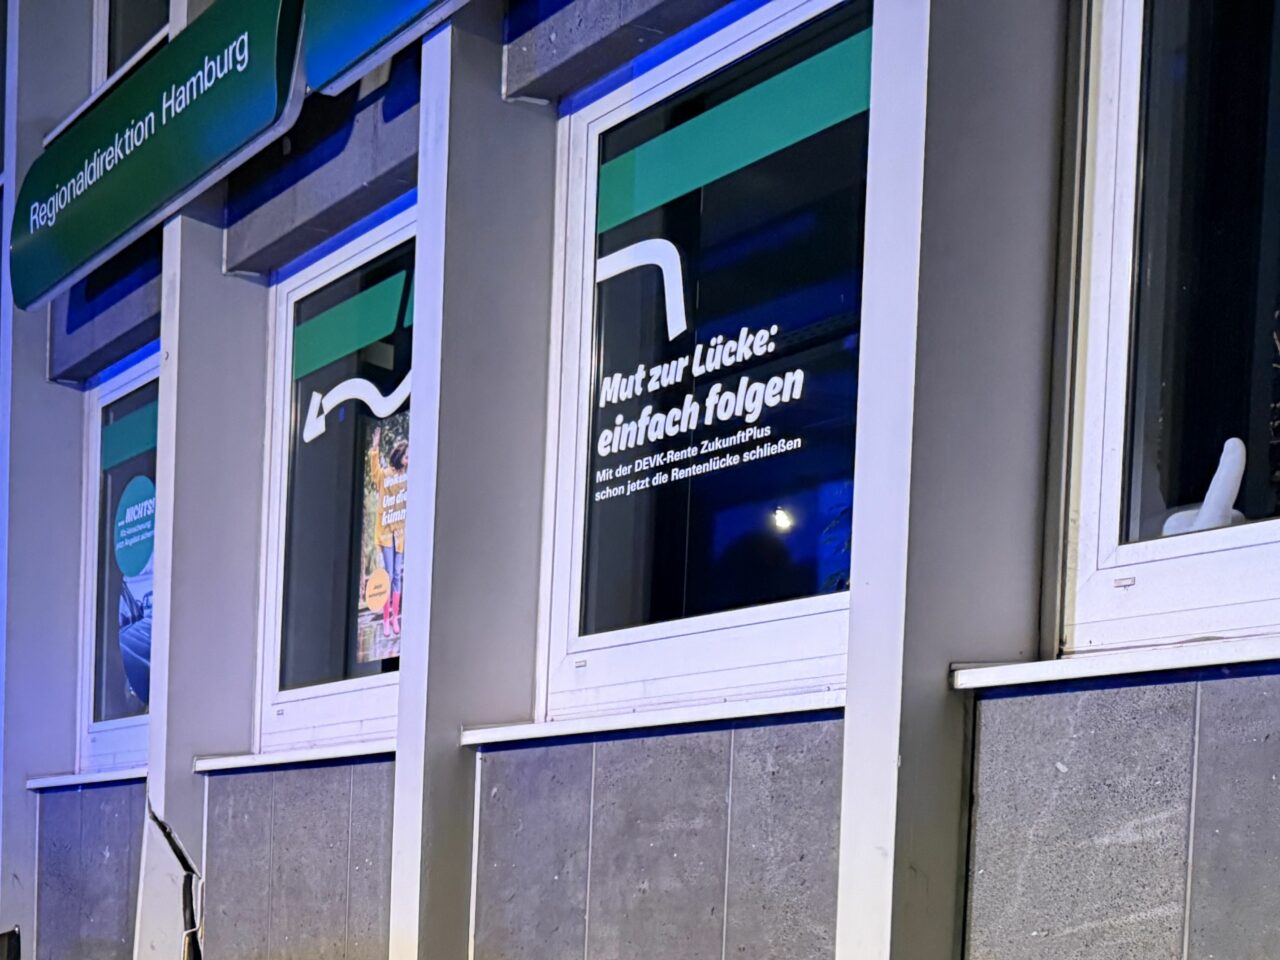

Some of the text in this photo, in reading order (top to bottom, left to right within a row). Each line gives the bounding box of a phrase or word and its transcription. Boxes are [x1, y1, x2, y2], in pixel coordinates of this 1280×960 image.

[29, 31, 249, 234] Regionaldirektion Hamburg
[600, 324, 778, 407] Mut zur Lücke:
[596, 425, 772, 483] Mit der DEVK-Rente ZukunftPlus
[597, 368, 805, 457] einfach folgen
[595, 437, 802, 501] schon jetzt die Rentenlücke schließen
